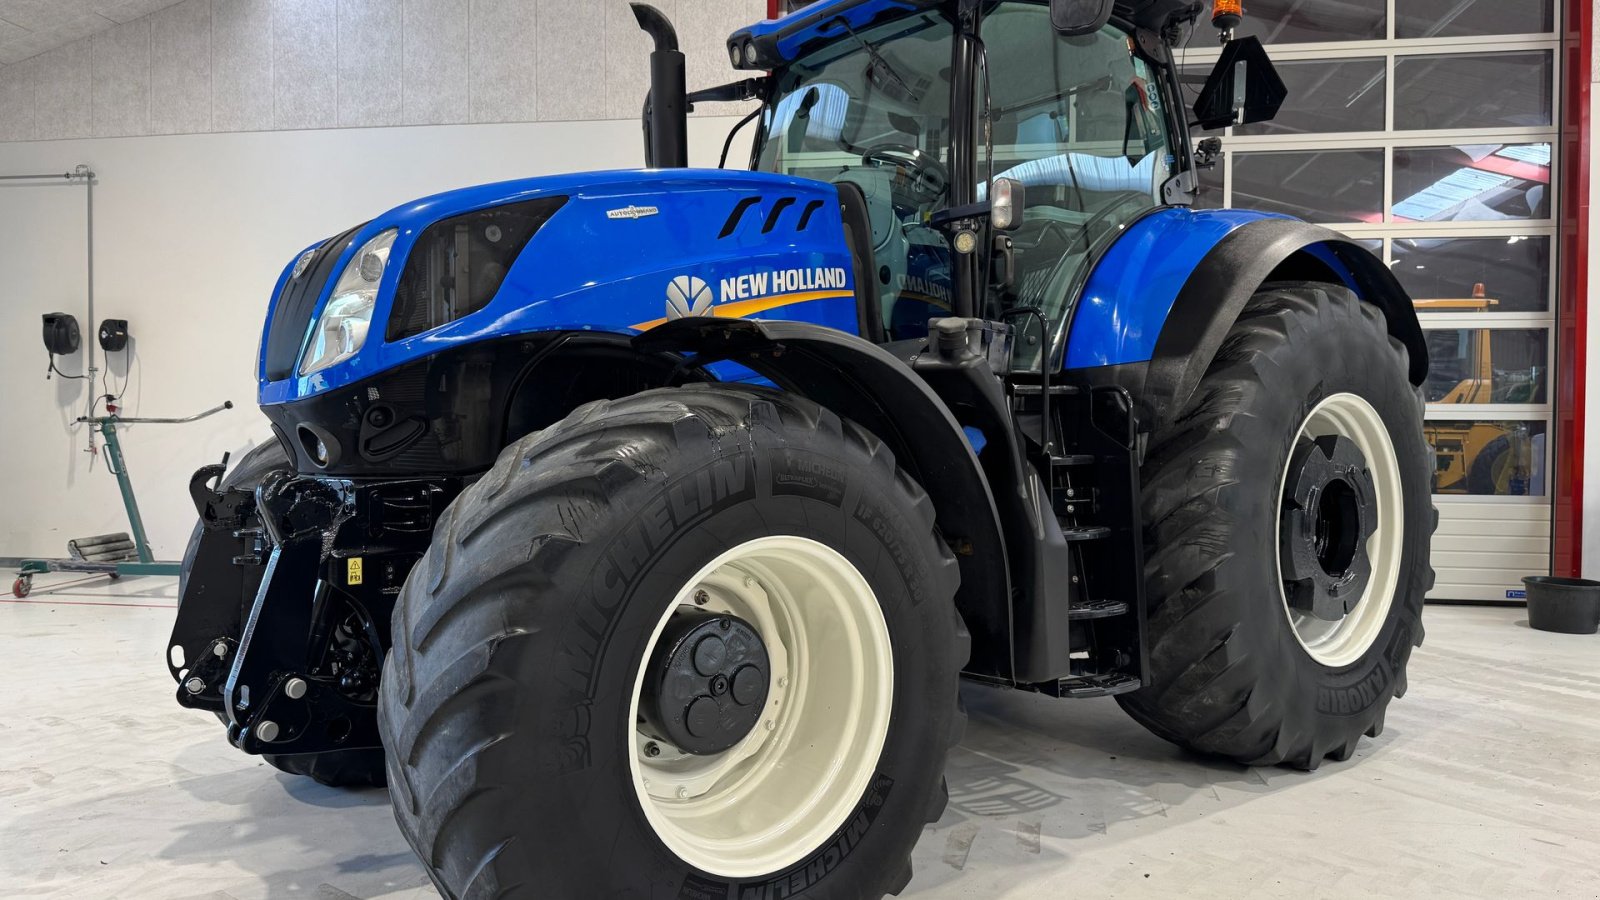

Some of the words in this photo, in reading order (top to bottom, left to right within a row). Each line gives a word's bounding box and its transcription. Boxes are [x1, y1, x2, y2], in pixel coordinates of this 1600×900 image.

[609, 207, 656, 217] AUTOCOMMAND
[720, 272, 768, 302] NEW
[772, 267, 846, 293] HOLLAND
[797, 460, 847, 482] MICHELIN
[561, 457, 748, 697] MICHELIN
[1318, 667, 1385, 713] AXIOBIB
[742, 809, 872, 900] MICHELIN
